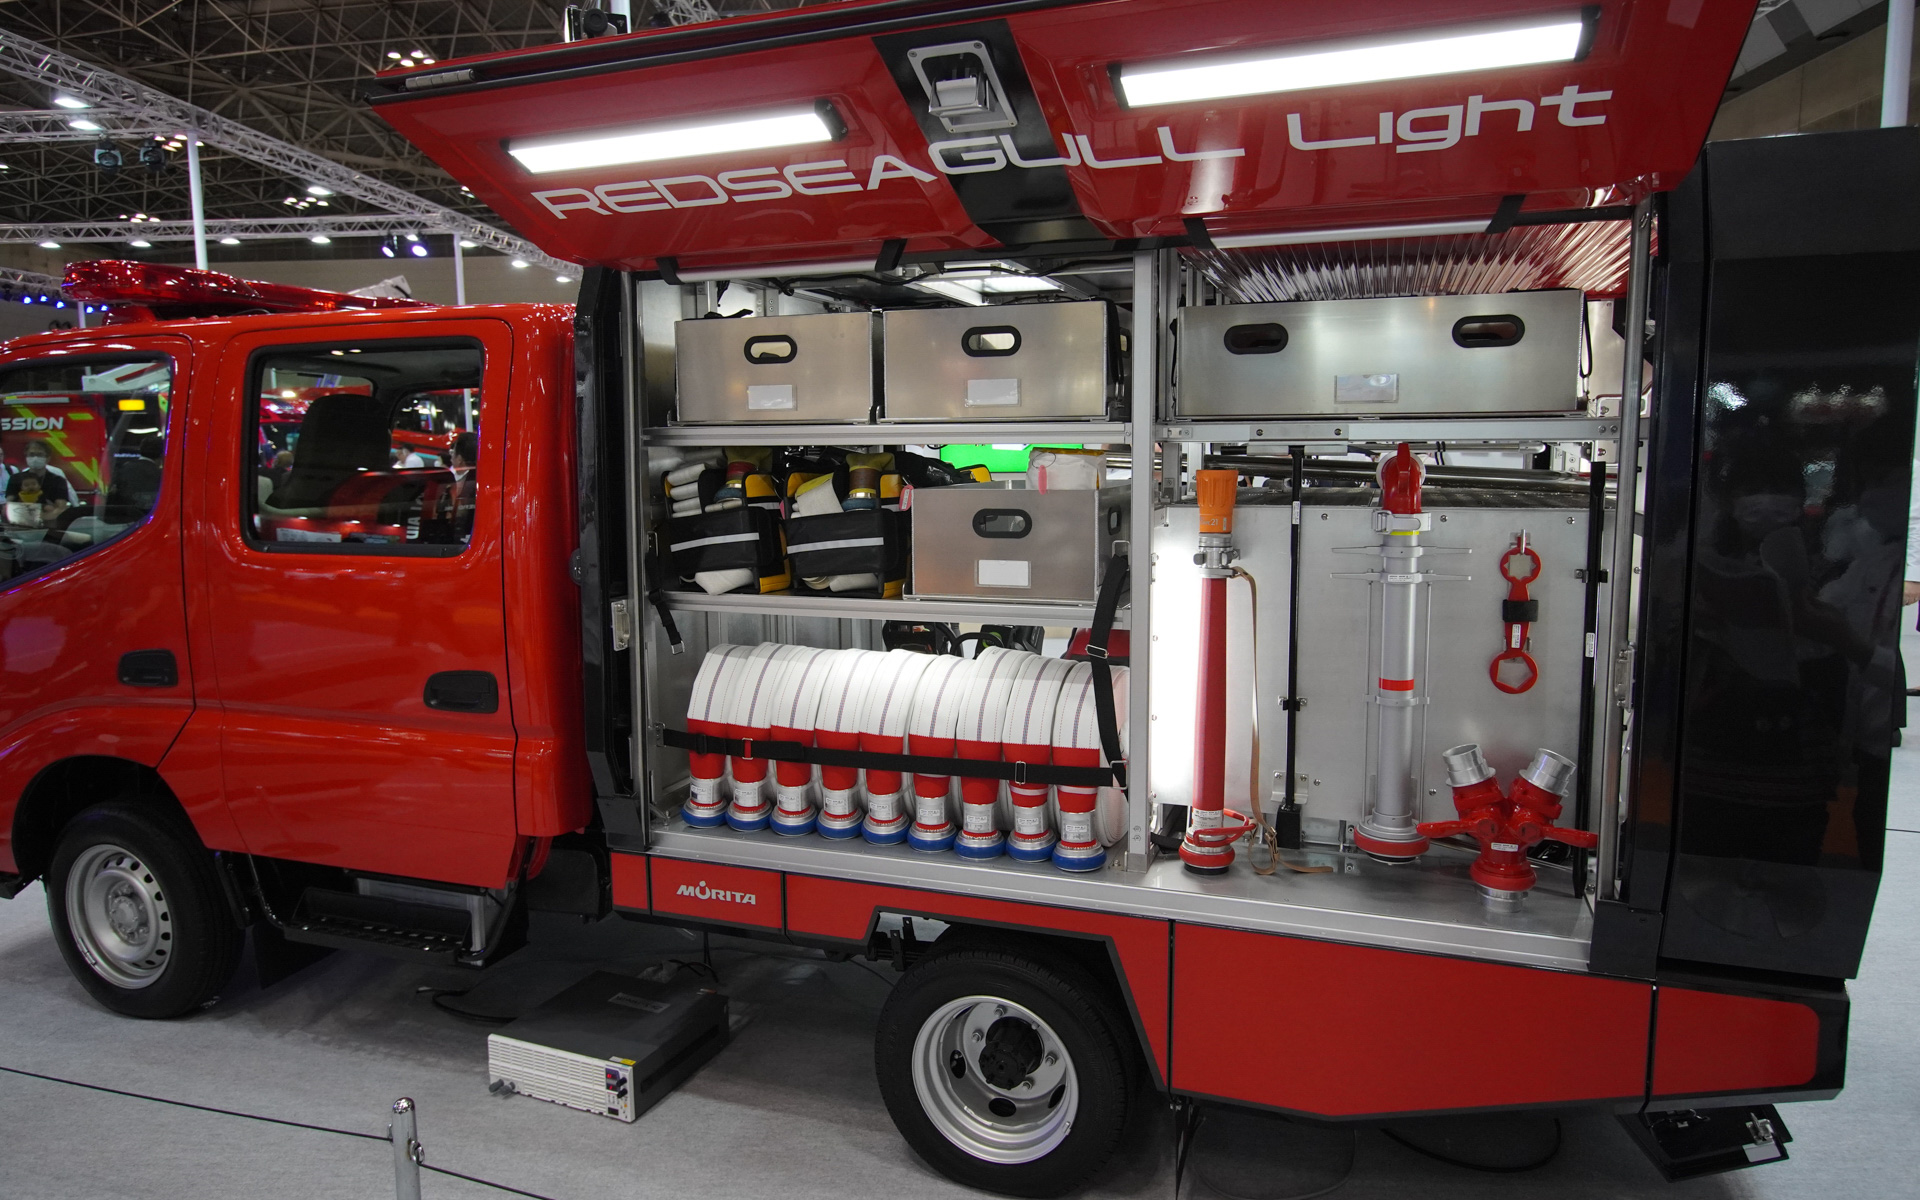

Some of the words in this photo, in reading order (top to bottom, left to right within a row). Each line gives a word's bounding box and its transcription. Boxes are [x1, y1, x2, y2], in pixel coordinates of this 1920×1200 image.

[531, 126, 1246, 220] REDSEAGULL
[1287, 85, 1613, 154] Light
[676, 880, 757, 905] MORITA
